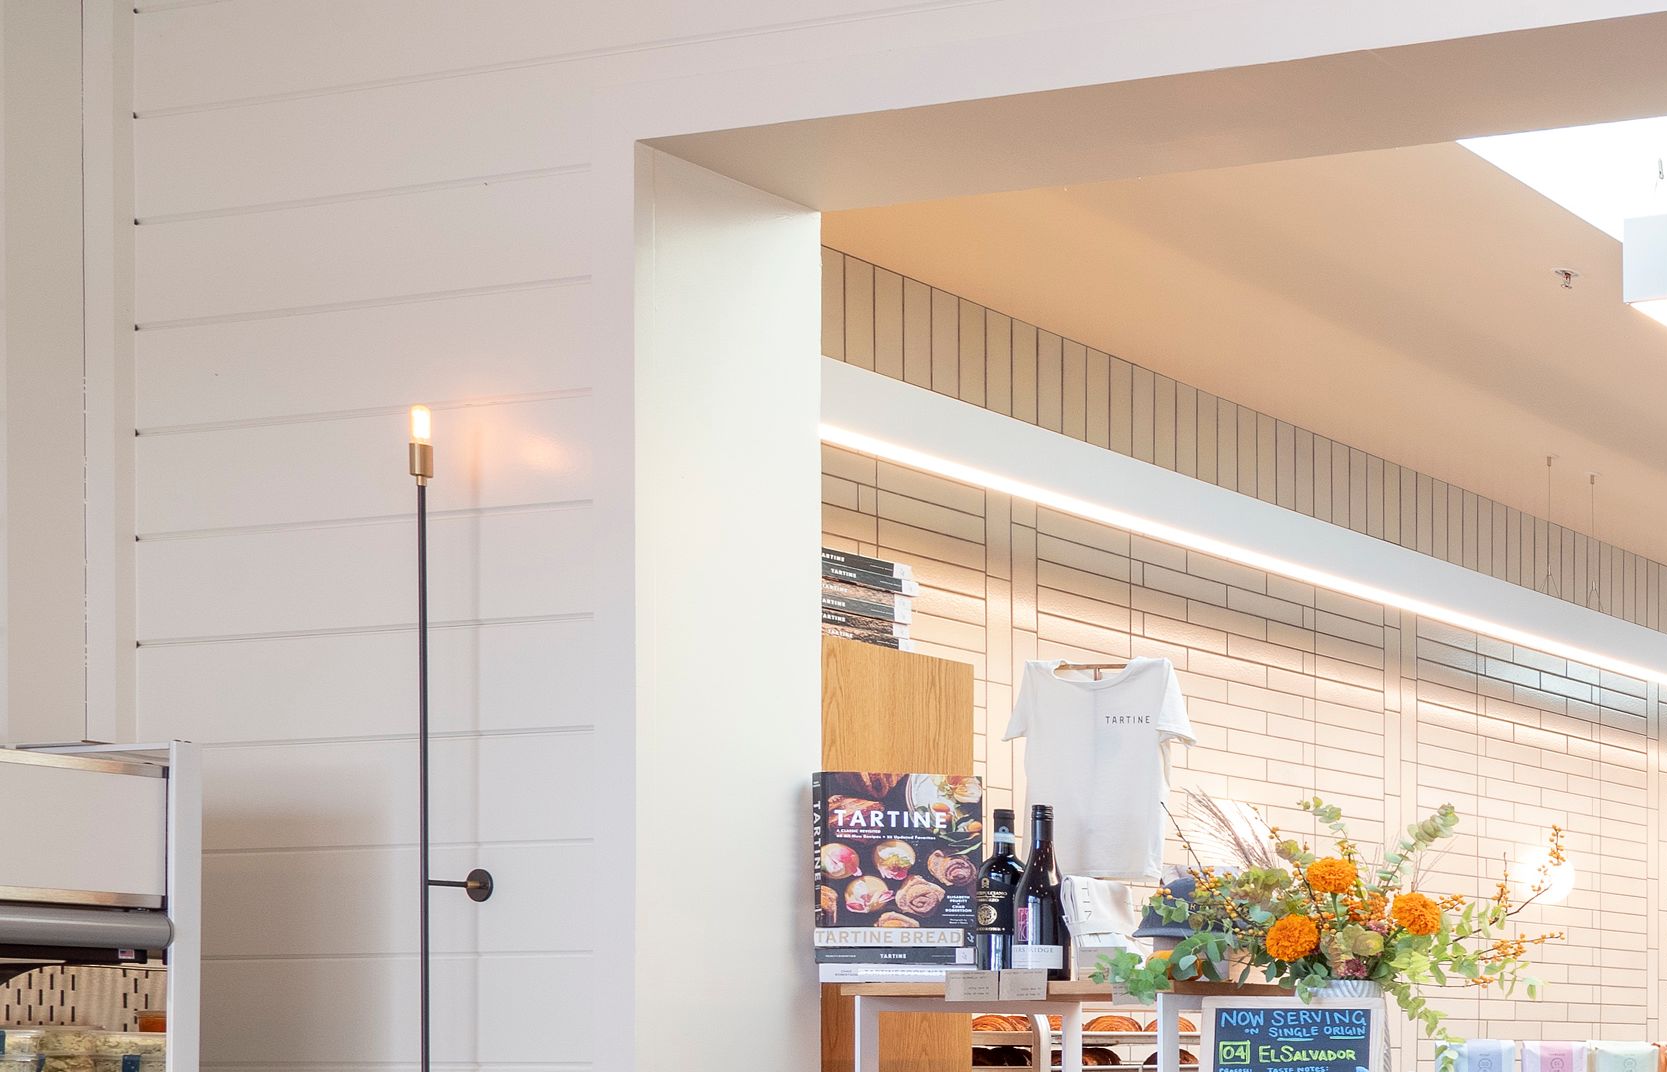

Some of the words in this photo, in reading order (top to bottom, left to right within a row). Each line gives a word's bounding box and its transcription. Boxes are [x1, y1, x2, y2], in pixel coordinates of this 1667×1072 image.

[821, 553, 845, 563] ARTINE
[822, 597, 846, 607] ARTINE
[1105, 715, 1151, 725] TARTINE
[834, 809, 948, 829] TARTINE
[812, 800, 822, 882] TARTINE
[815, 930, 893, 944] TARTINE
[900, 930, 962, 944] BREAD
[1220, 1010, 1265, 1028] NOW
[1271, 1010, 1367, 1027] SERVING
[1268, 1026, 1319, 1038] SINGLE
[1323, 1026, 1366, 1036] ORIGIN
[1222, 1045, 1247, 1060] 04
